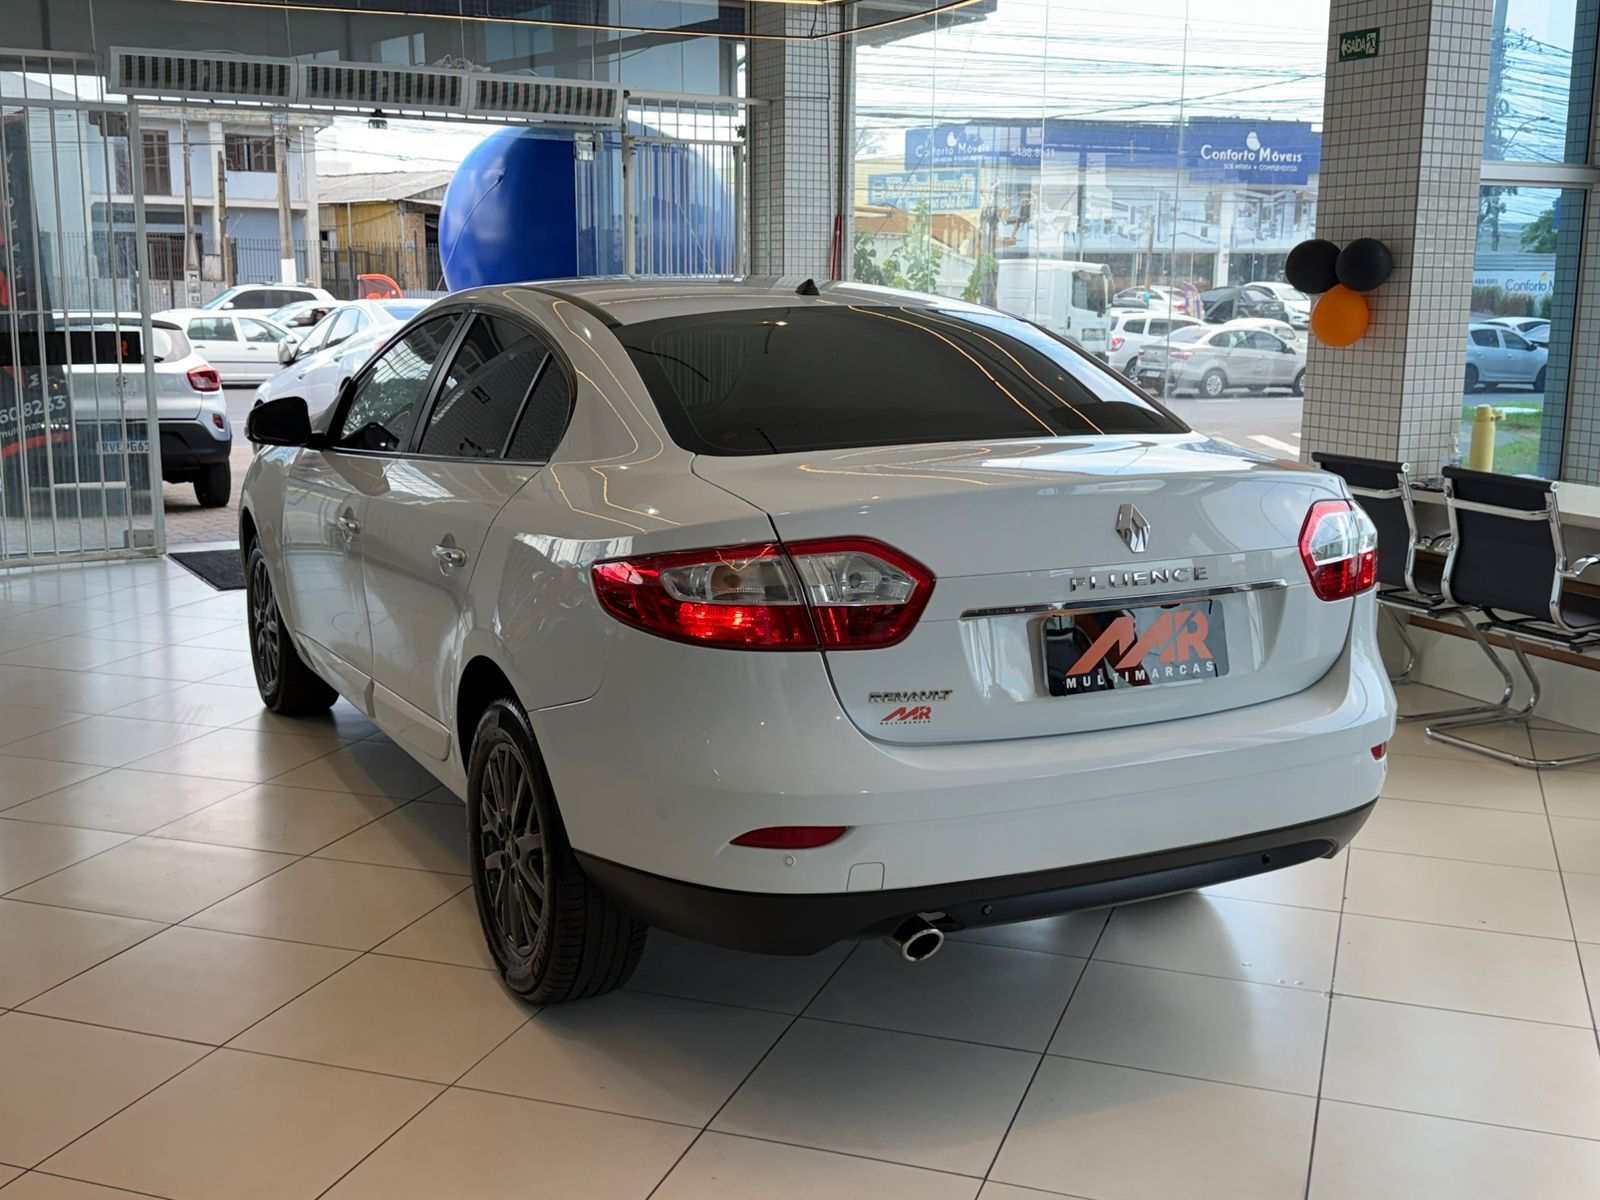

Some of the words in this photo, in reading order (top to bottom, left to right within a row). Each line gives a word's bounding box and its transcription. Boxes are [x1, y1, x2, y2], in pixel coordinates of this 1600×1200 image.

[1346, 35, 1365, 54] SAÍDA
[1200, 144, 1256, 160] Conforto
[1258, 147, 1303, 162] Móveis
[1505, 278, 1547, 292] Conforto
[1070, 566, 1209, 592] FLUENCE
[1066, 661, 1214, 689] MULTIMARCAS
[869, 690, 953, 703] RENAULT
